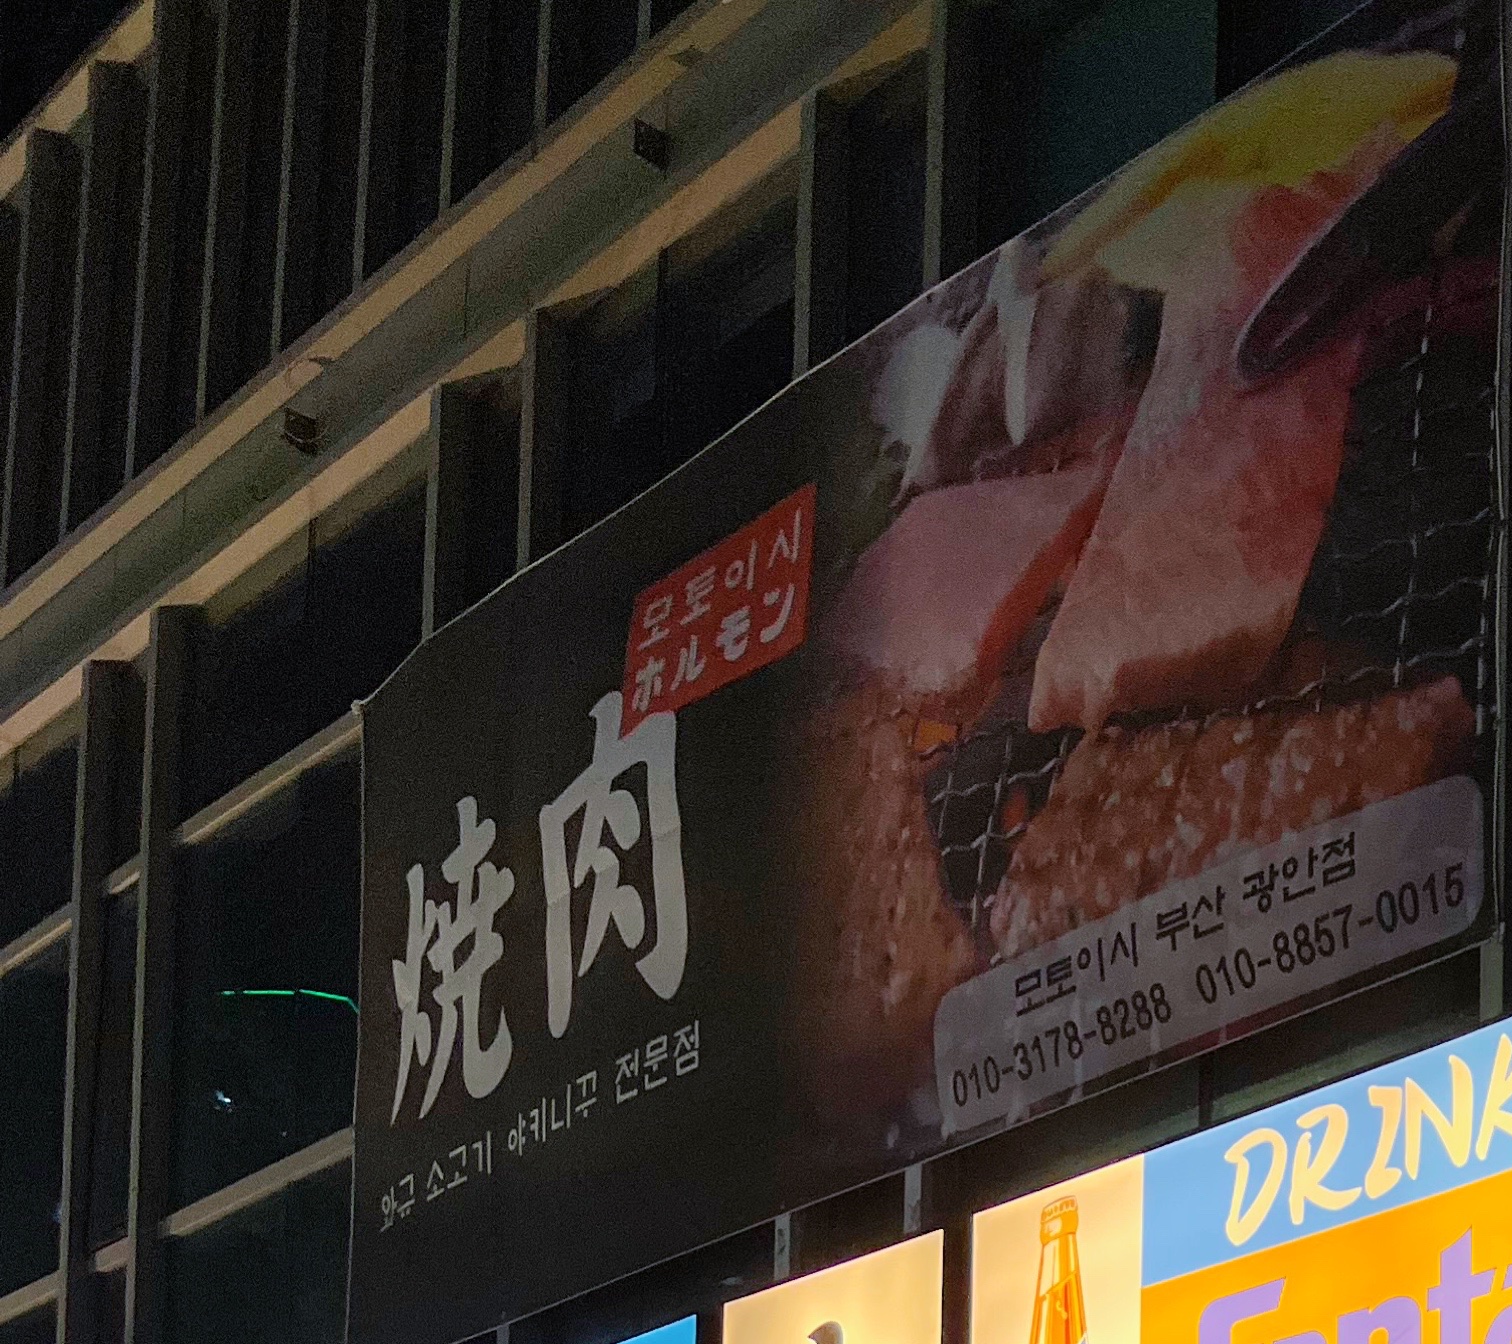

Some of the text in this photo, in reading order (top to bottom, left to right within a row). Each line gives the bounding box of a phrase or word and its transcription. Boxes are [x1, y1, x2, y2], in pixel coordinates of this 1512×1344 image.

[631, 583, 797, 714] ホルモン
[638, 506, 802, 654] 모토이시
[392, 690, 689, 1127] 焼肉
[951, 873, 1465, 1109] 010-3178-8288 010-8857-0015
[1014, 831, 1356, 1017] 모토이시 부산 광안점
[425, 1131, 493, 1202] 소고기
[614, 1019, 701, 1104] 전문점
